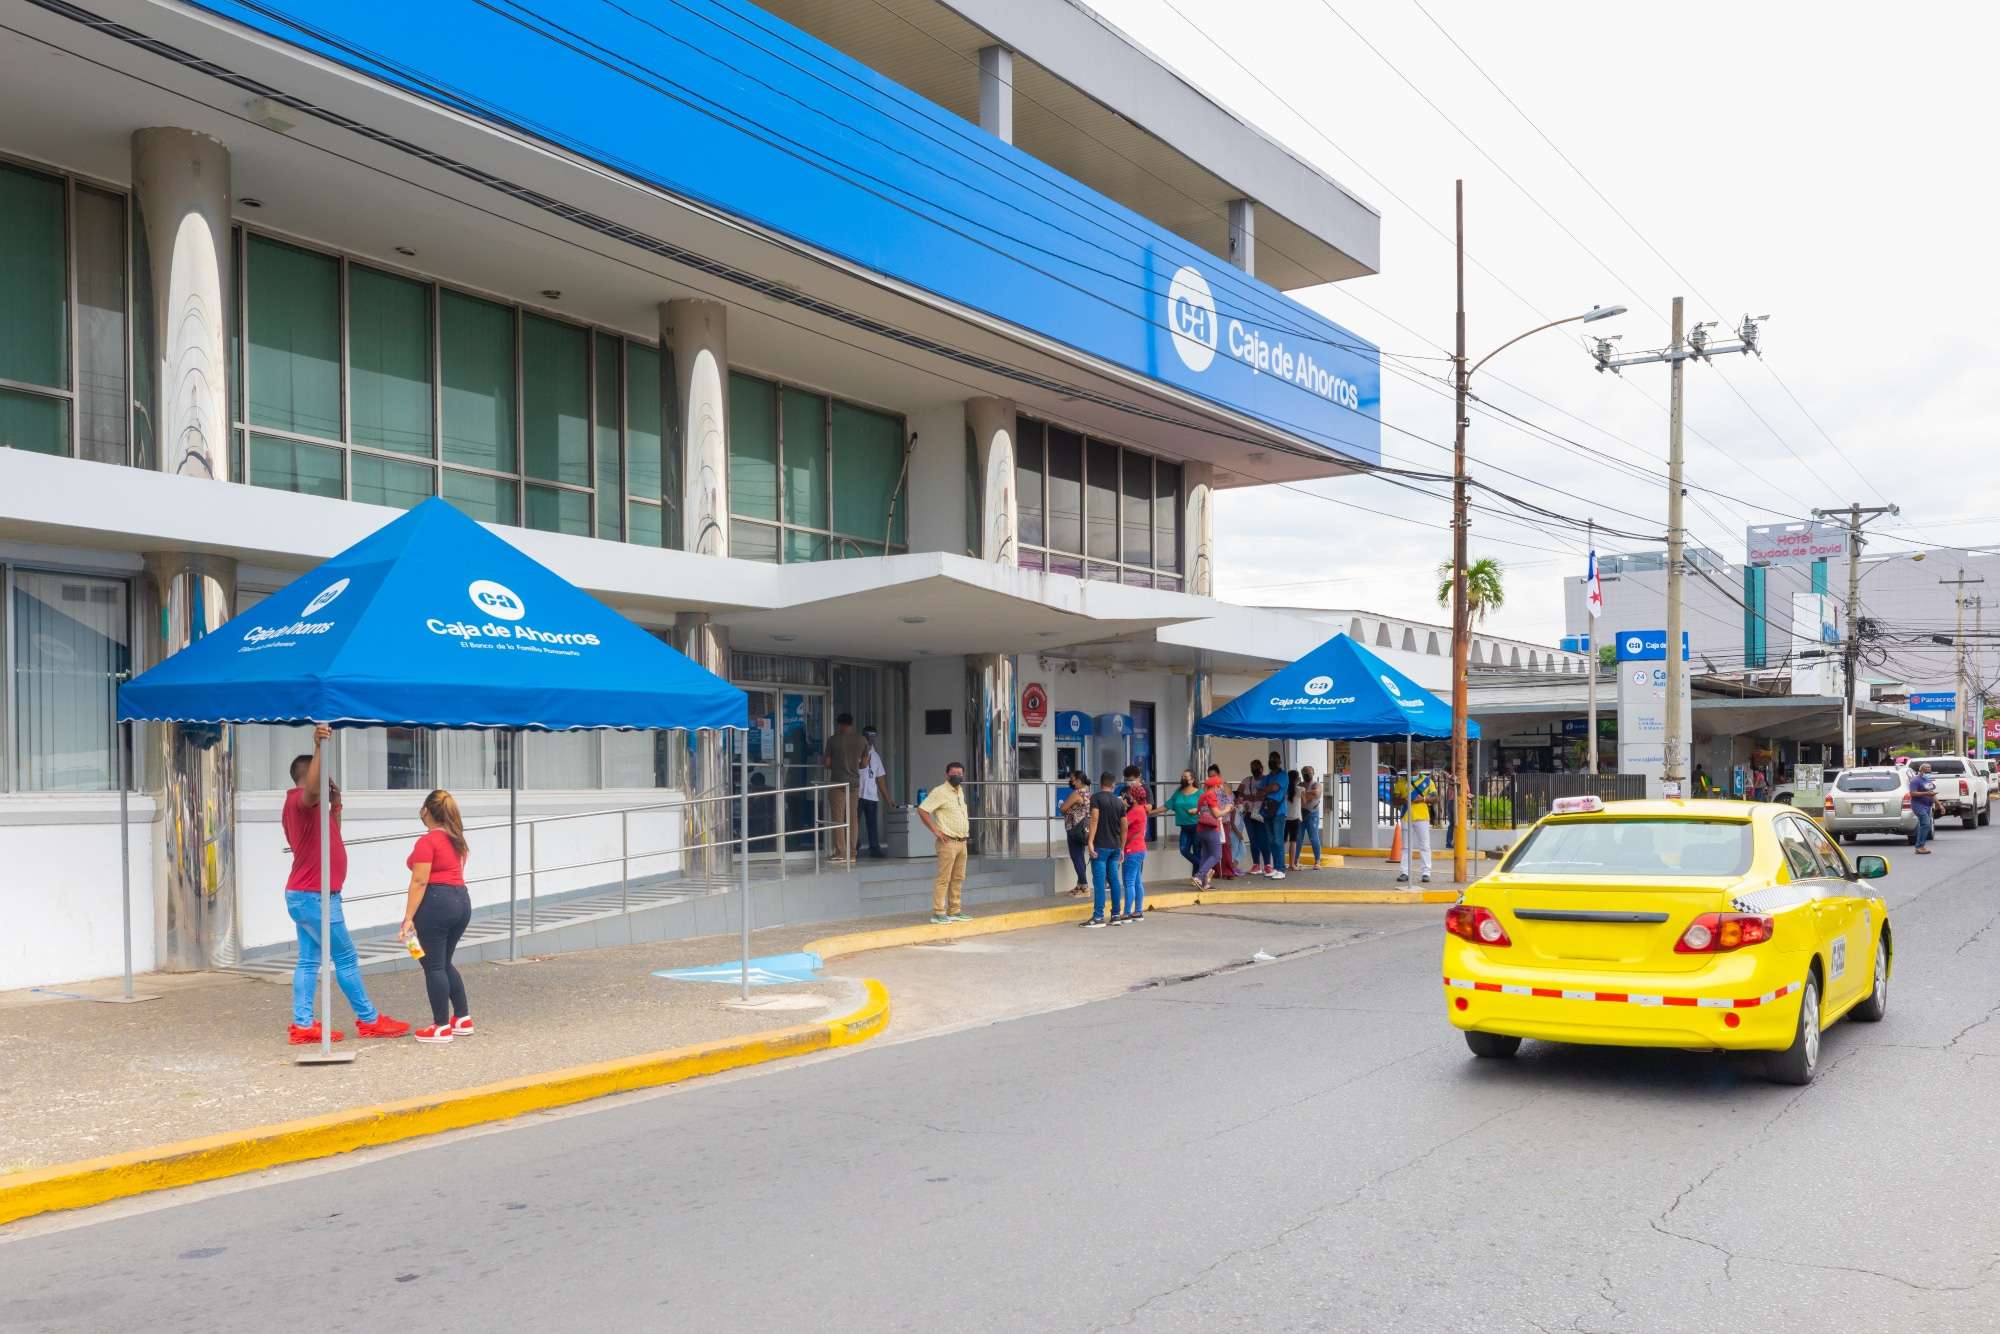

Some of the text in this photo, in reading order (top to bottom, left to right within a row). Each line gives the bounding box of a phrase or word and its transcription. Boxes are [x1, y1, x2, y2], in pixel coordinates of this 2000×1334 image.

[1228, 319, 1358, 410] Caja de Ahorros
[1776, 532, 1813, 545] Hotel
[1750, 543, 1842, 559] Ciudad de David
[426, 618, 601, 646] Caja de Ahorros
[1645, 642, 1660, 650] Caja
[1270, 696, 1356, 707] Caja de Ahorros
